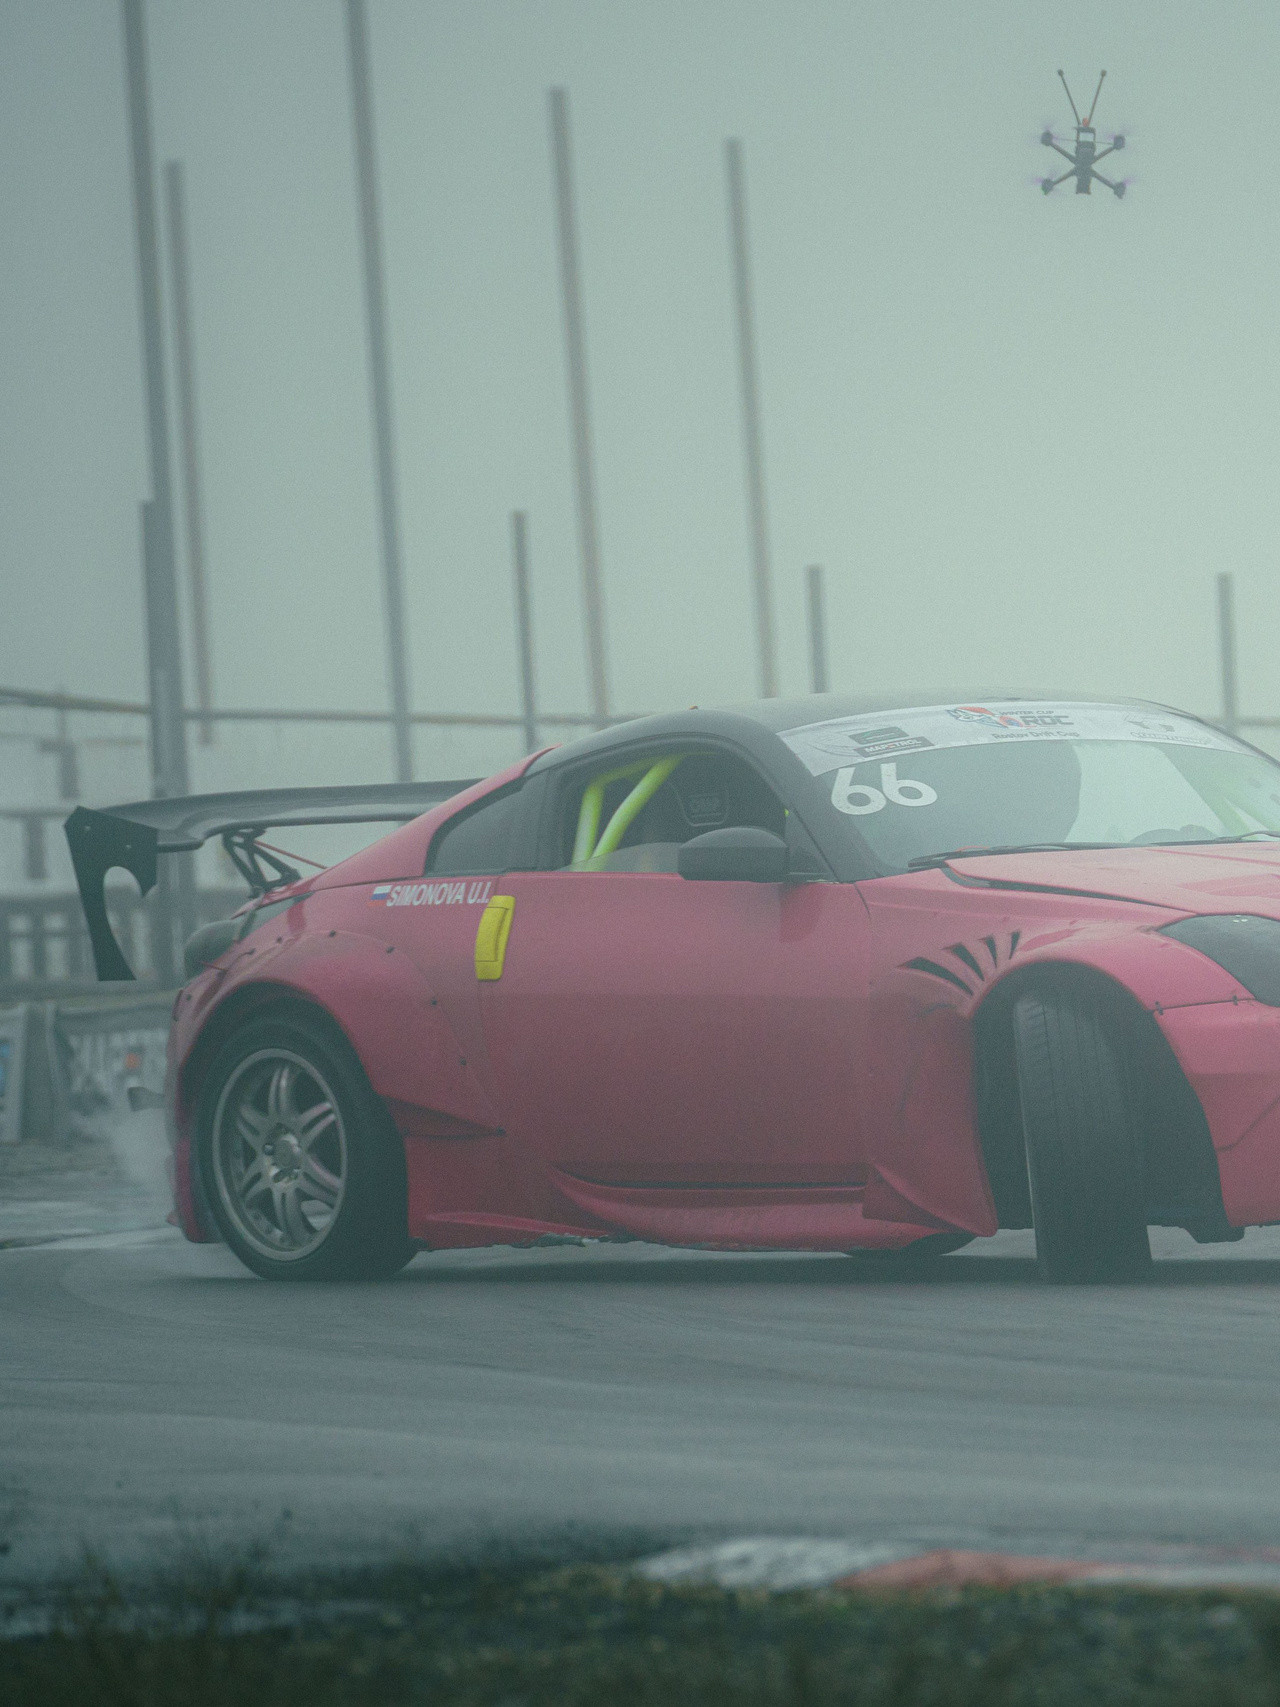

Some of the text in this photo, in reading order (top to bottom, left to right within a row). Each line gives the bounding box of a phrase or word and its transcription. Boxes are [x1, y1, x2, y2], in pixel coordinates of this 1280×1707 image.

[1020, 715, 1074, 726] RDC
[831, 762, 938, 815] 66
[386, 882, 466, 907] SIMONOVA
